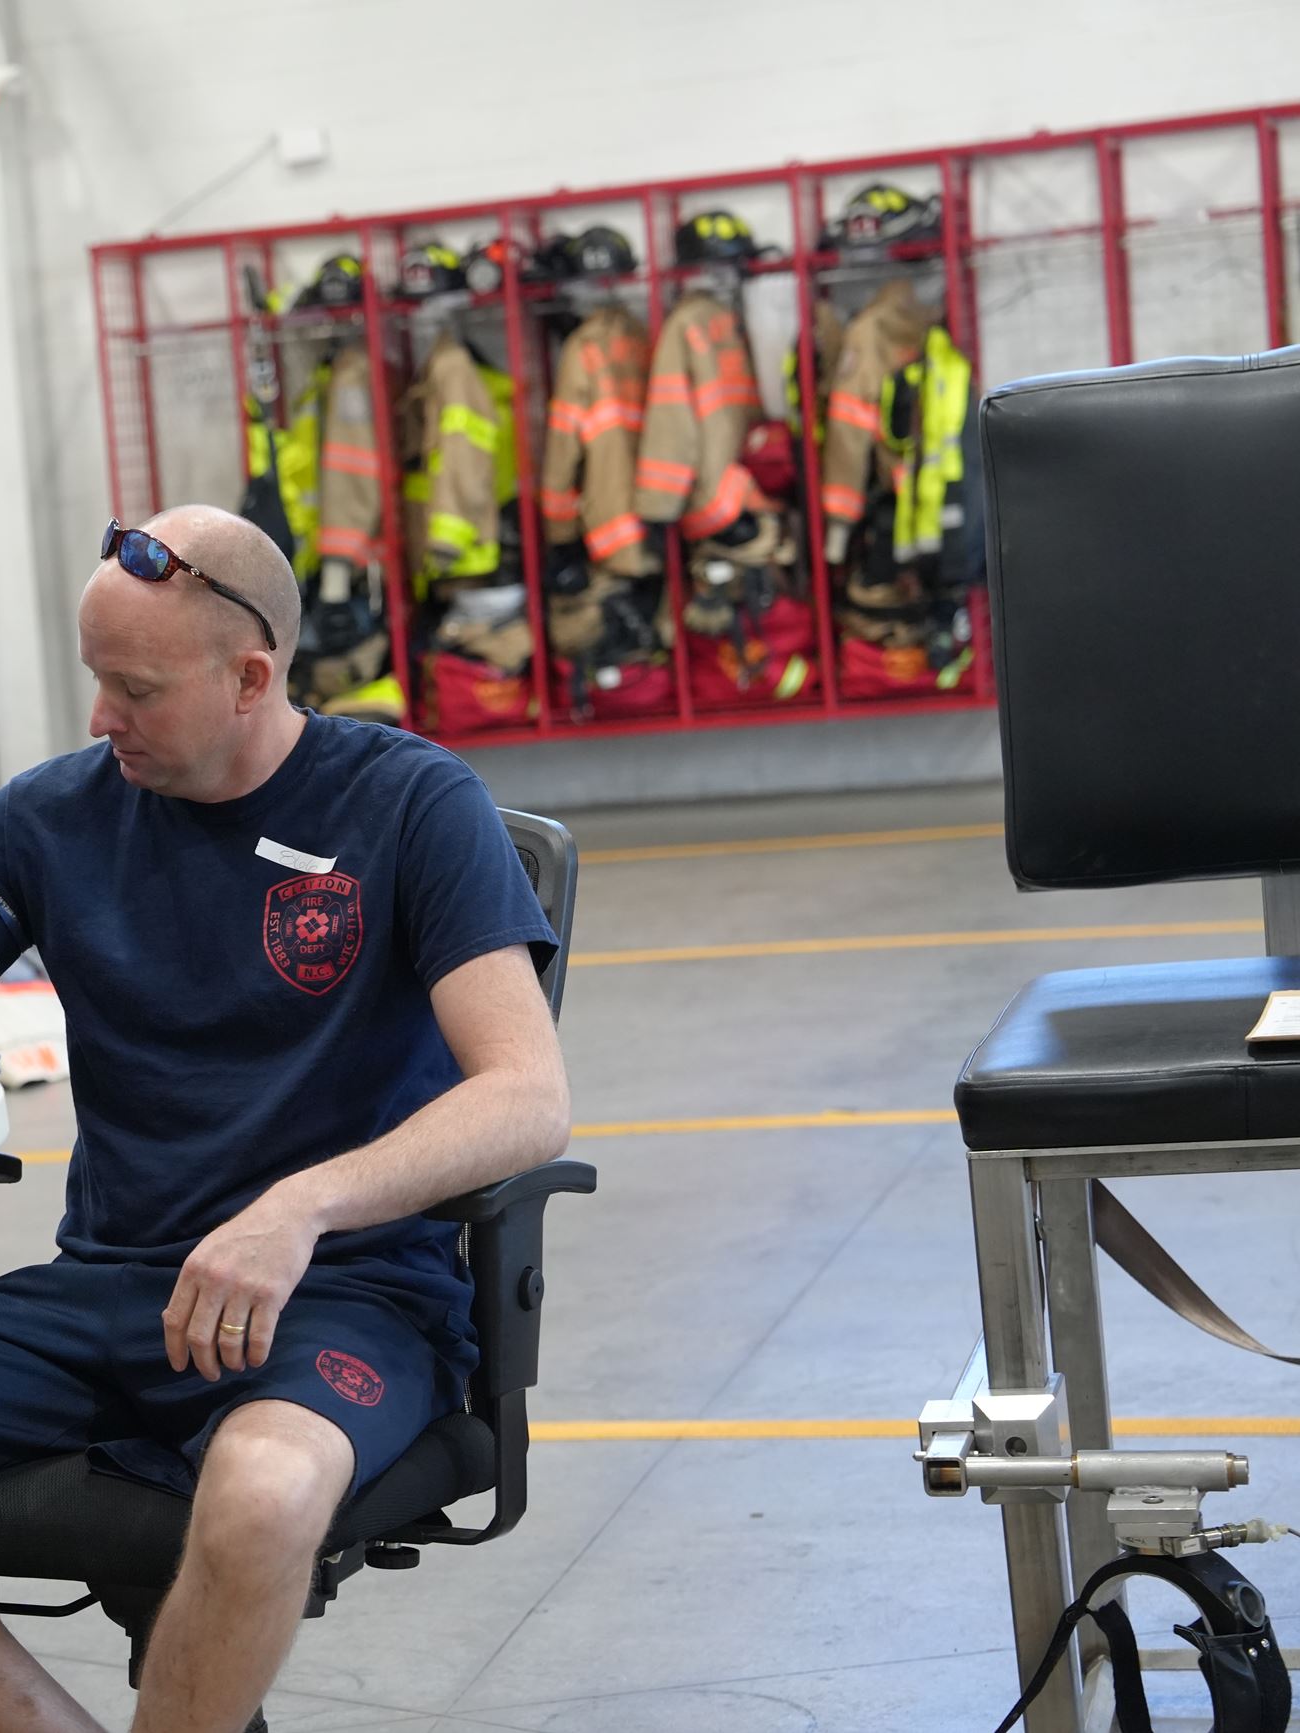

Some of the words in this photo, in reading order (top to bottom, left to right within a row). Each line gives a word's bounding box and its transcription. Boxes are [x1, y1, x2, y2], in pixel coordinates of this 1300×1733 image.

[282, 878, 347, 899] CLAYTON
[301, 896, 324, 907] FIRE
[269, 911, 281, 937] EST.
[271, 938, 291, 968] 1883
[300, 943, 325, 954] DEPT
[304, 966, 330, 978] N.C.
